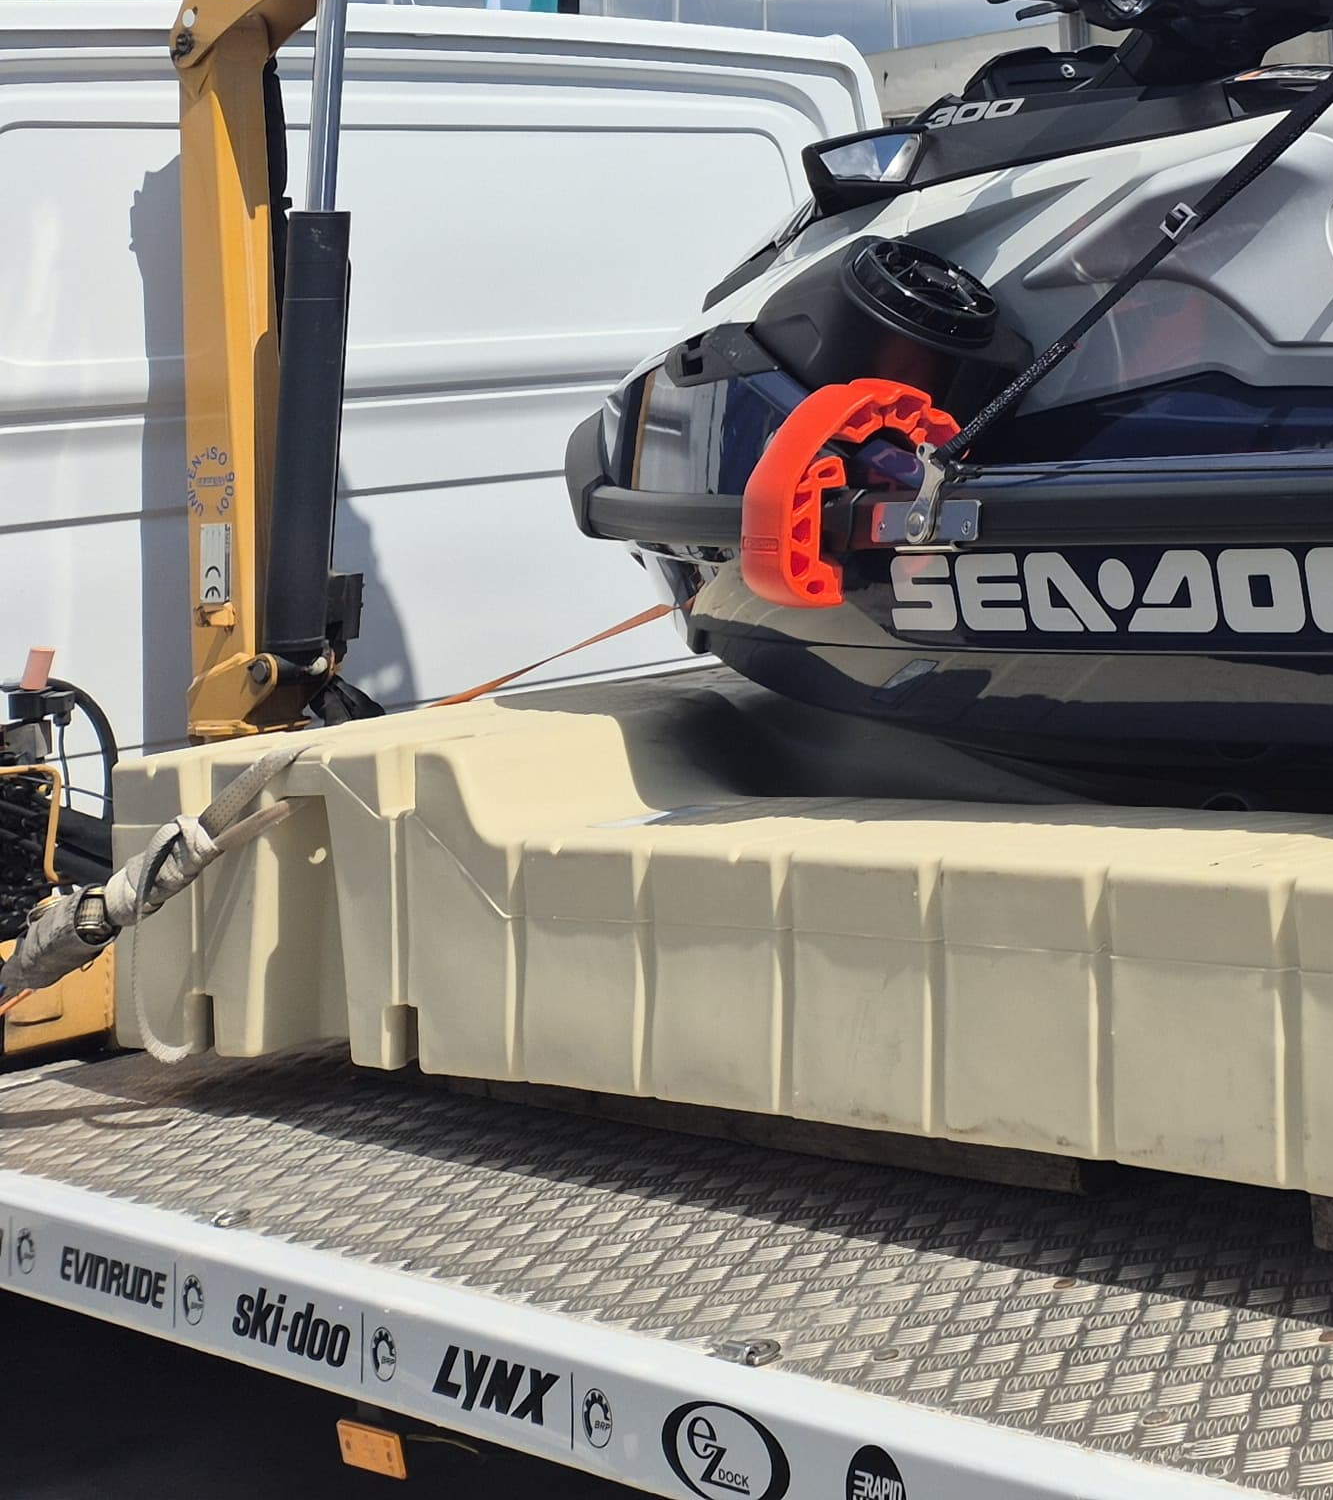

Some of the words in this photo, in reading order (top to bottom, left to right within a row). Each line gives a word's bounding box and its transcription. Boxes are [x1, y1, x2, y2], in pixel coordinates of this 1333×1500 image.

[924, 98, 1025, 130] 300
[60, 1245, 168, 1310] EVINRUDE
[232, 1287, 351, 1368] ski-doo
[432, 1344, 561, 1426] LYNX
[594, 1419, 611, 1432] BRP
[718, 1468, 749, 1489] DOCK
